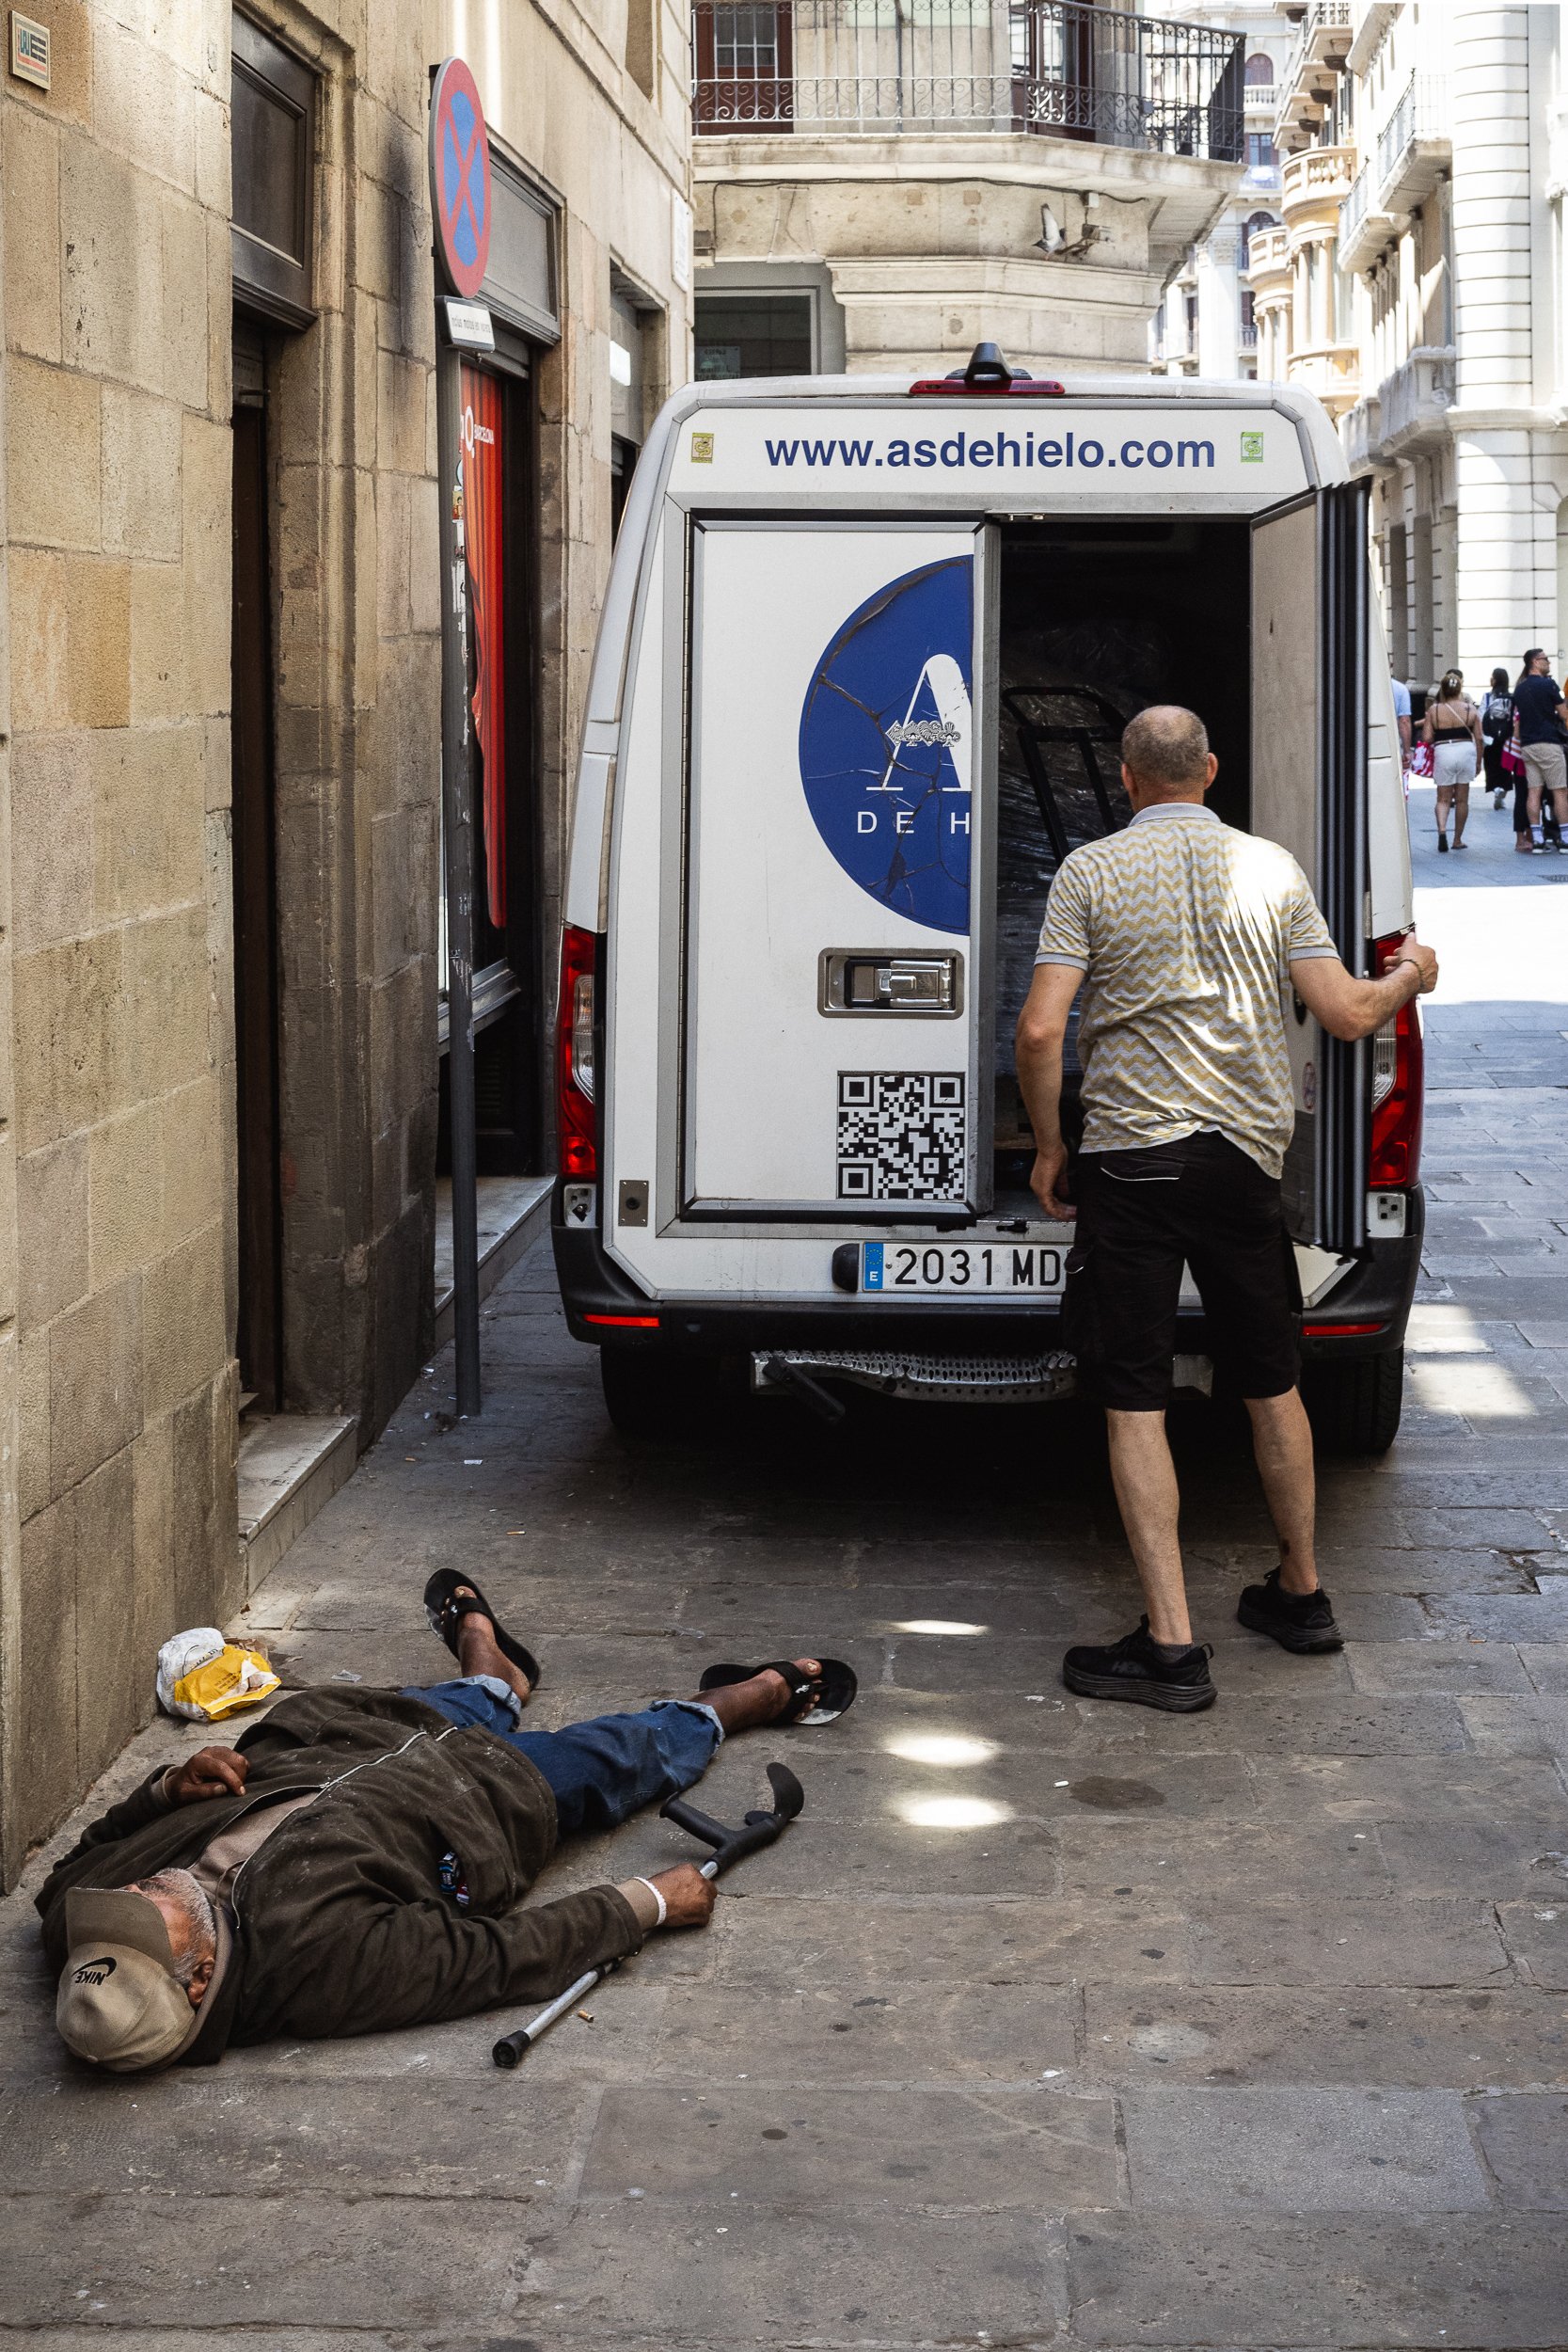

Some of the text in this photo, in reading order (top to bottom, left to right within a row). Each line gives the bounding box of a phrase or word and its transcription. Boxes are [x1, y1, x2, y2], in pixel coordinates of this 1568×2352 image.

[765, 432, 1214, 469] www.asdehielo.com
[857, 811, 915, 834] DE
[869, 1271, 879, 1282] E
[895, 1248, 992, 1286] 2031
[74, 1971, 106, 1986] NIKE
